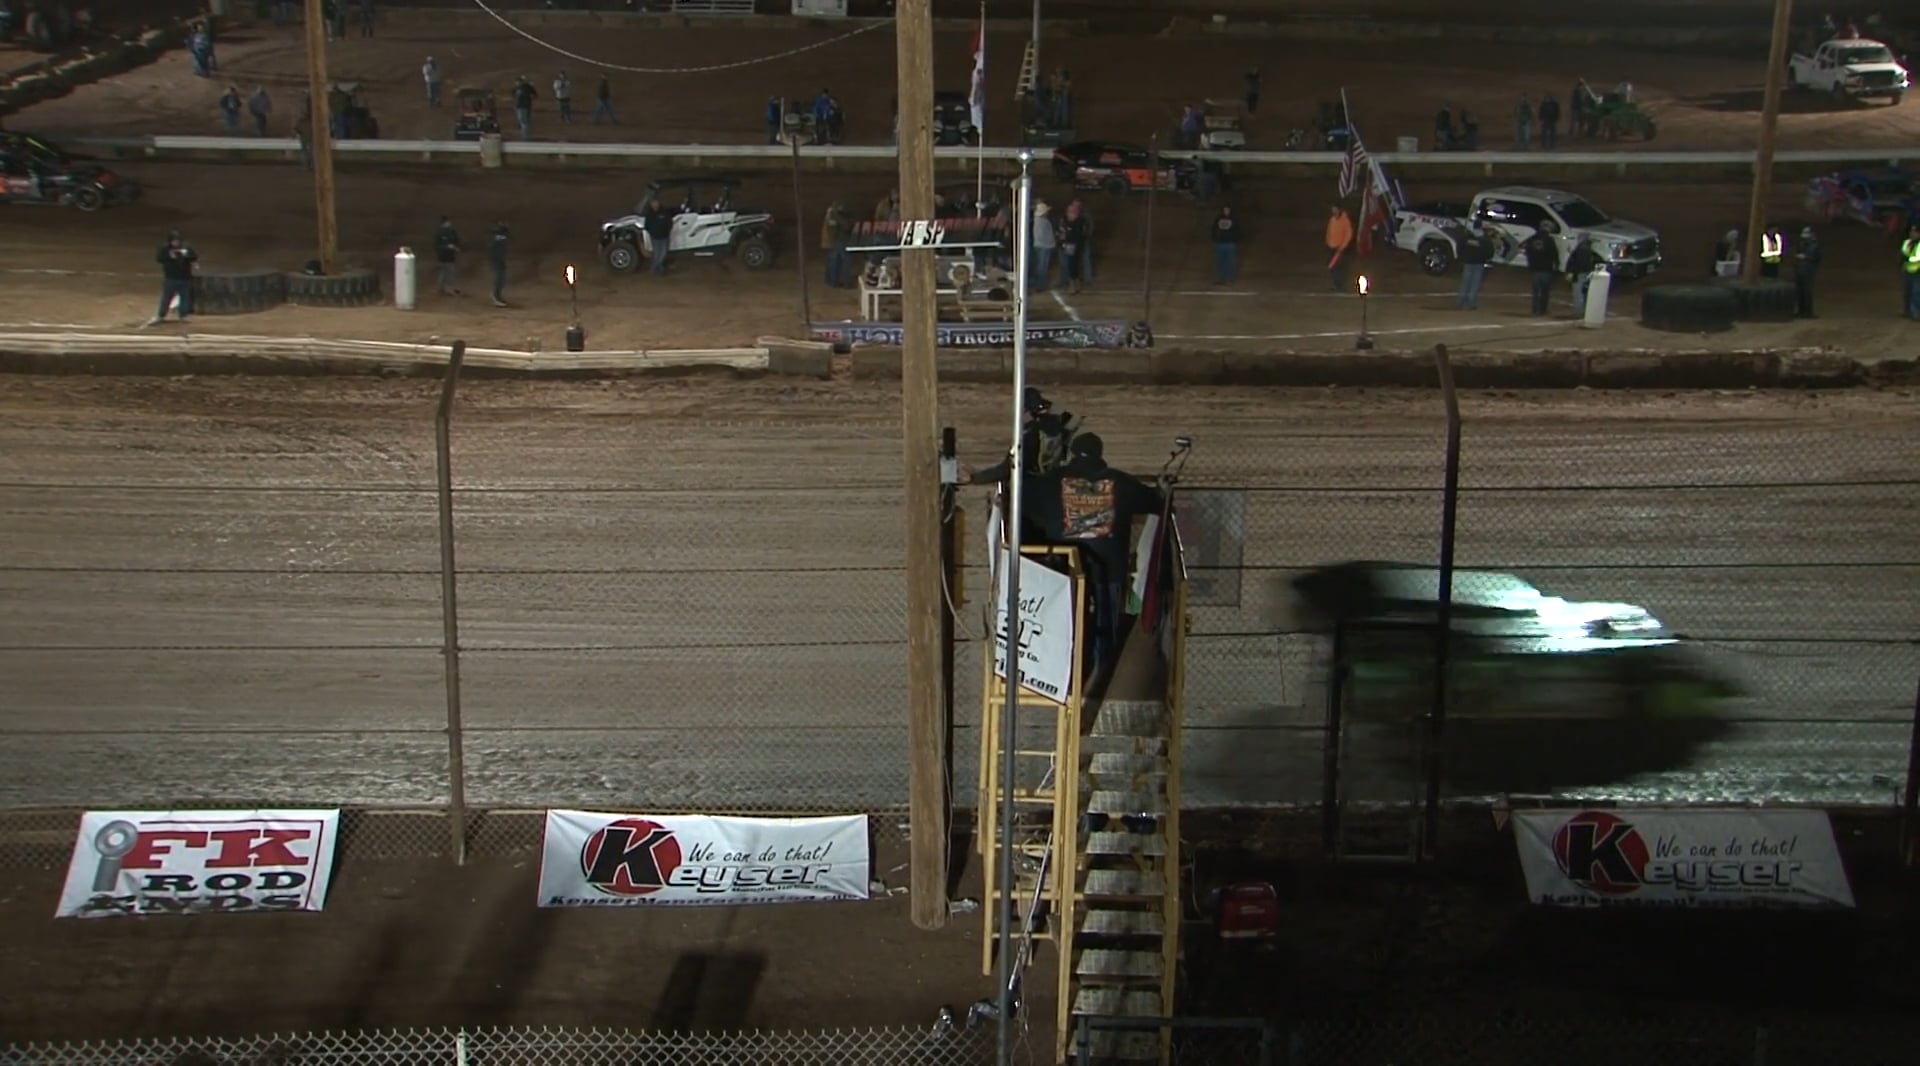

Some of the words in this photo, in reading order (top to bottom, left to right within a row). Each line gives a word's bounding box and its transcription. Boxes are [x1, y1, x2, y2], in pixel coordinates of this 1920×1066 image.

[121, 829, 311, 869] FK
[586, 827, 833, 893] Keyser
[689, 841, 716, 862] We
[723, 850, 752, 863] can
[758, 844, 777, 862] do
[785, 841, 833, 862] that!
[1566, 822, 1803, 892] Keyser
[1656, 834, 1680, 858] We
[1690, 844, 1717, 857] can
[1725, 837, 1742, 857] do
[1751, 836, 1798, 857] that!
[141, 871, 307, 892] ROD
